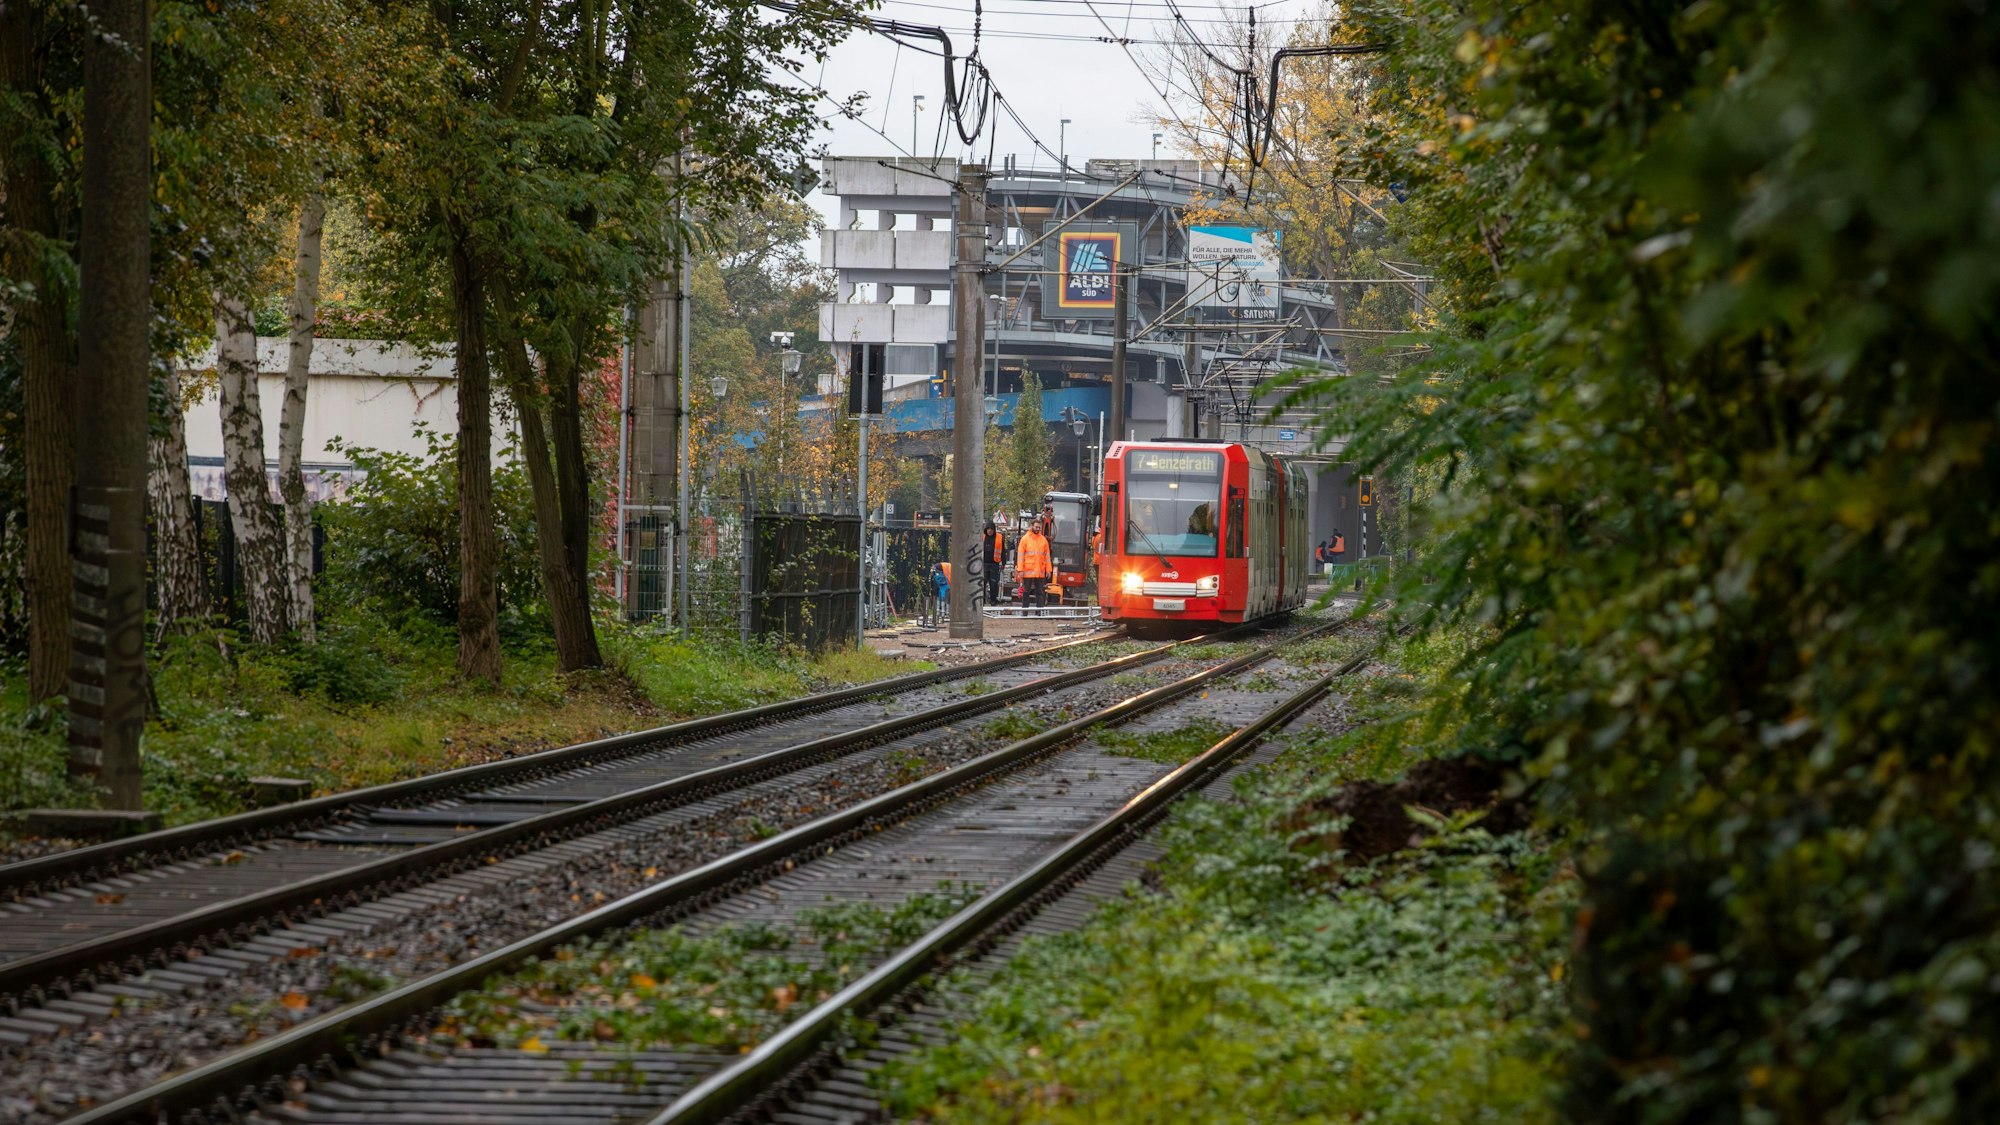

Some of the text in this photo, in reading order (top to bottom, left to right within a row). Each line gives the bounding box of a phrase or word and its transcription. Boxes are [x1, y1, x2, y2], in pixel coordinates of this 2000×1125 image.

[1069, 275, 1109, 288] ALDI
[1082, 289, 1097, 297] SÜD
[1243, 309, 1275, 319] SATURN
[1138, 454, 1146, 469] 7
[966, 543, 984, 612] HOME
